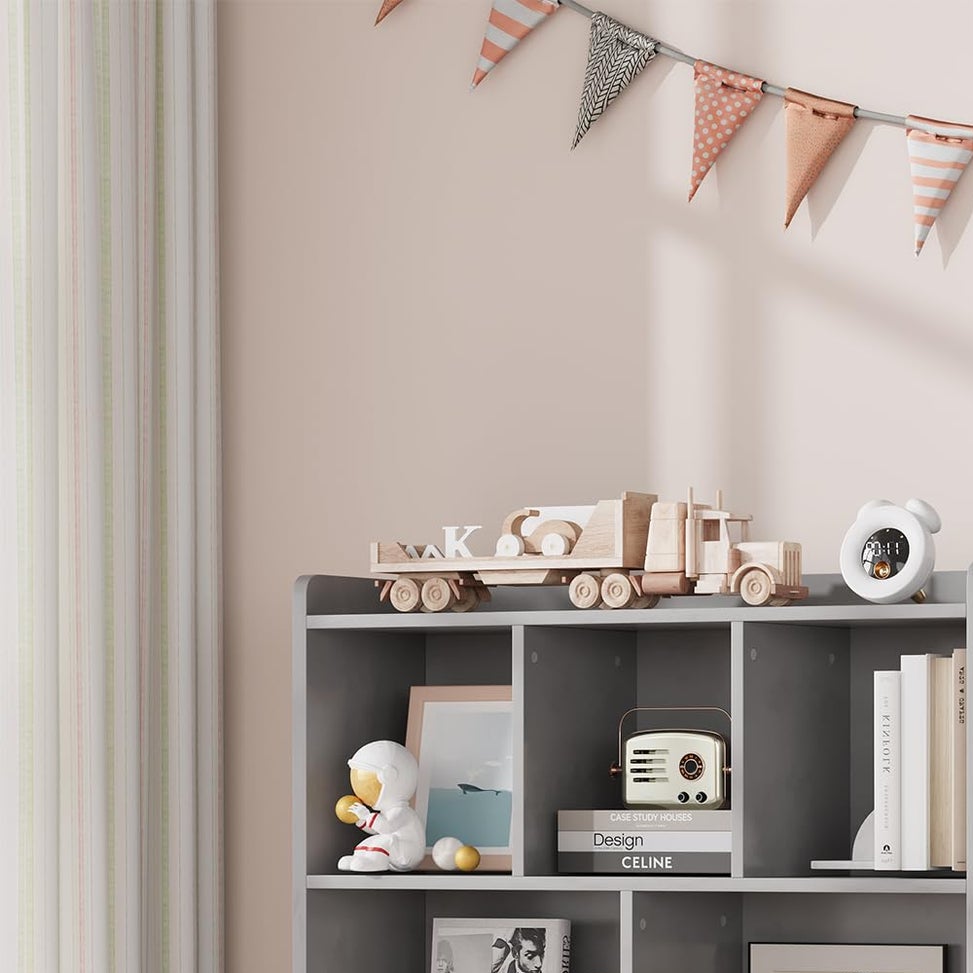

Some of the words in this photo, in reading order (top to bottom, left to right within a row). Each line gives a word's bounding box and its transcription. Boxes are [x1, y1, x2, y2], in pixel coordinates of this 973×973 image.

[609, 812, 631, 822] CASE
[632, 813, 658, 822] STUDY
[660, 813, 693, 822] HOUSES
[593, 832, 644, 850] Design
[621, 856, 673, 869] CELINE
